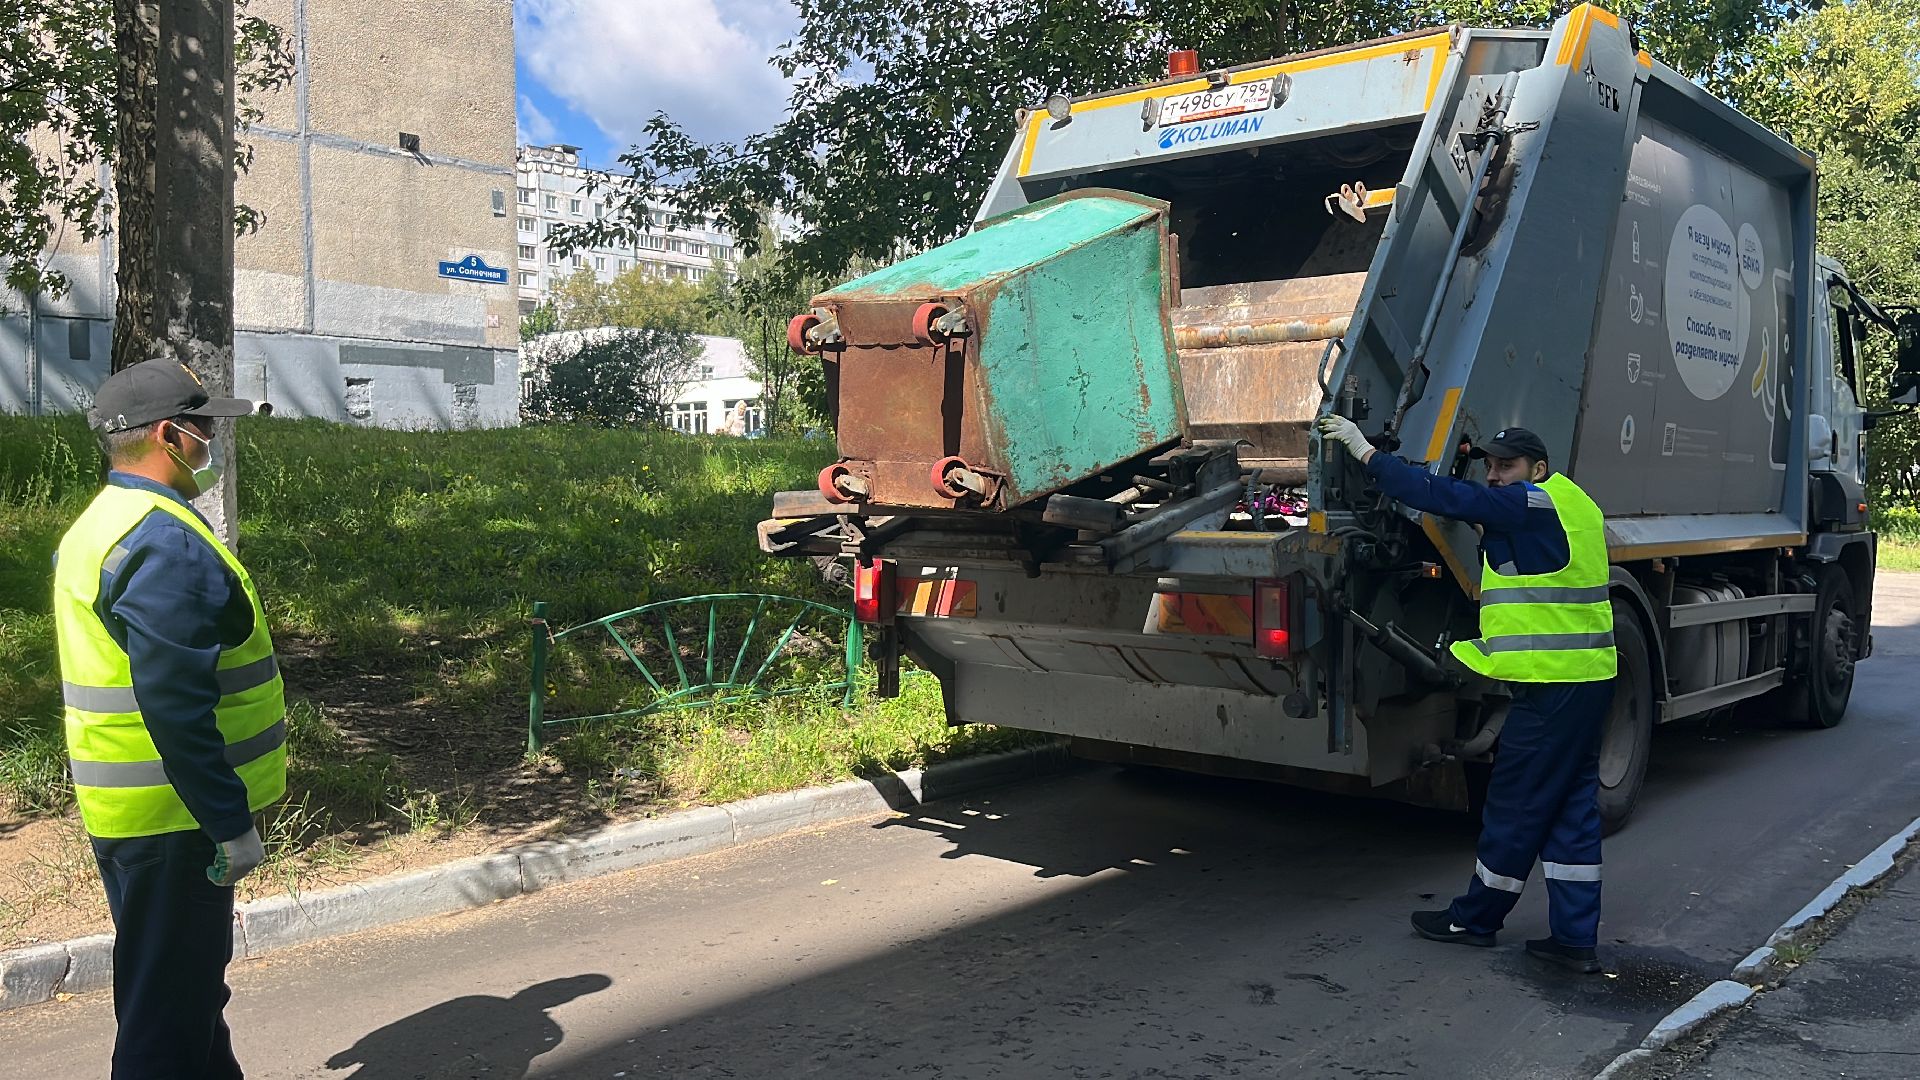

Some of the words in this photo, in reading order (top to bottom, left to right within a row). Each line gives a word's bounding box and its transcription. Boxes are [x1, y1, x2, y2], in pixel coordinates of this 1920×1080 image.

[1240, 82, 1267, 99] 799
[1174, 116, 1264, 144] KOLUMAN
[1687, 225, 1693, 241] Я
[1694, 231, 1710, 250] везу
[1711, 237, 1731, 259] мусор
[446, 266, 456, 274] ул.
[459, 266, 501, 279] Солнечная
[471, 257, 477, 266] 5
[1742, 254, 1760, 274] БАКА
[1686, 316, 1717, 341] Спасибо,
[1717, 327, 1731, 342] что
[1675, 341, 1718, 361] разделяете
[1718, 351, 1740, 370] мусор!
